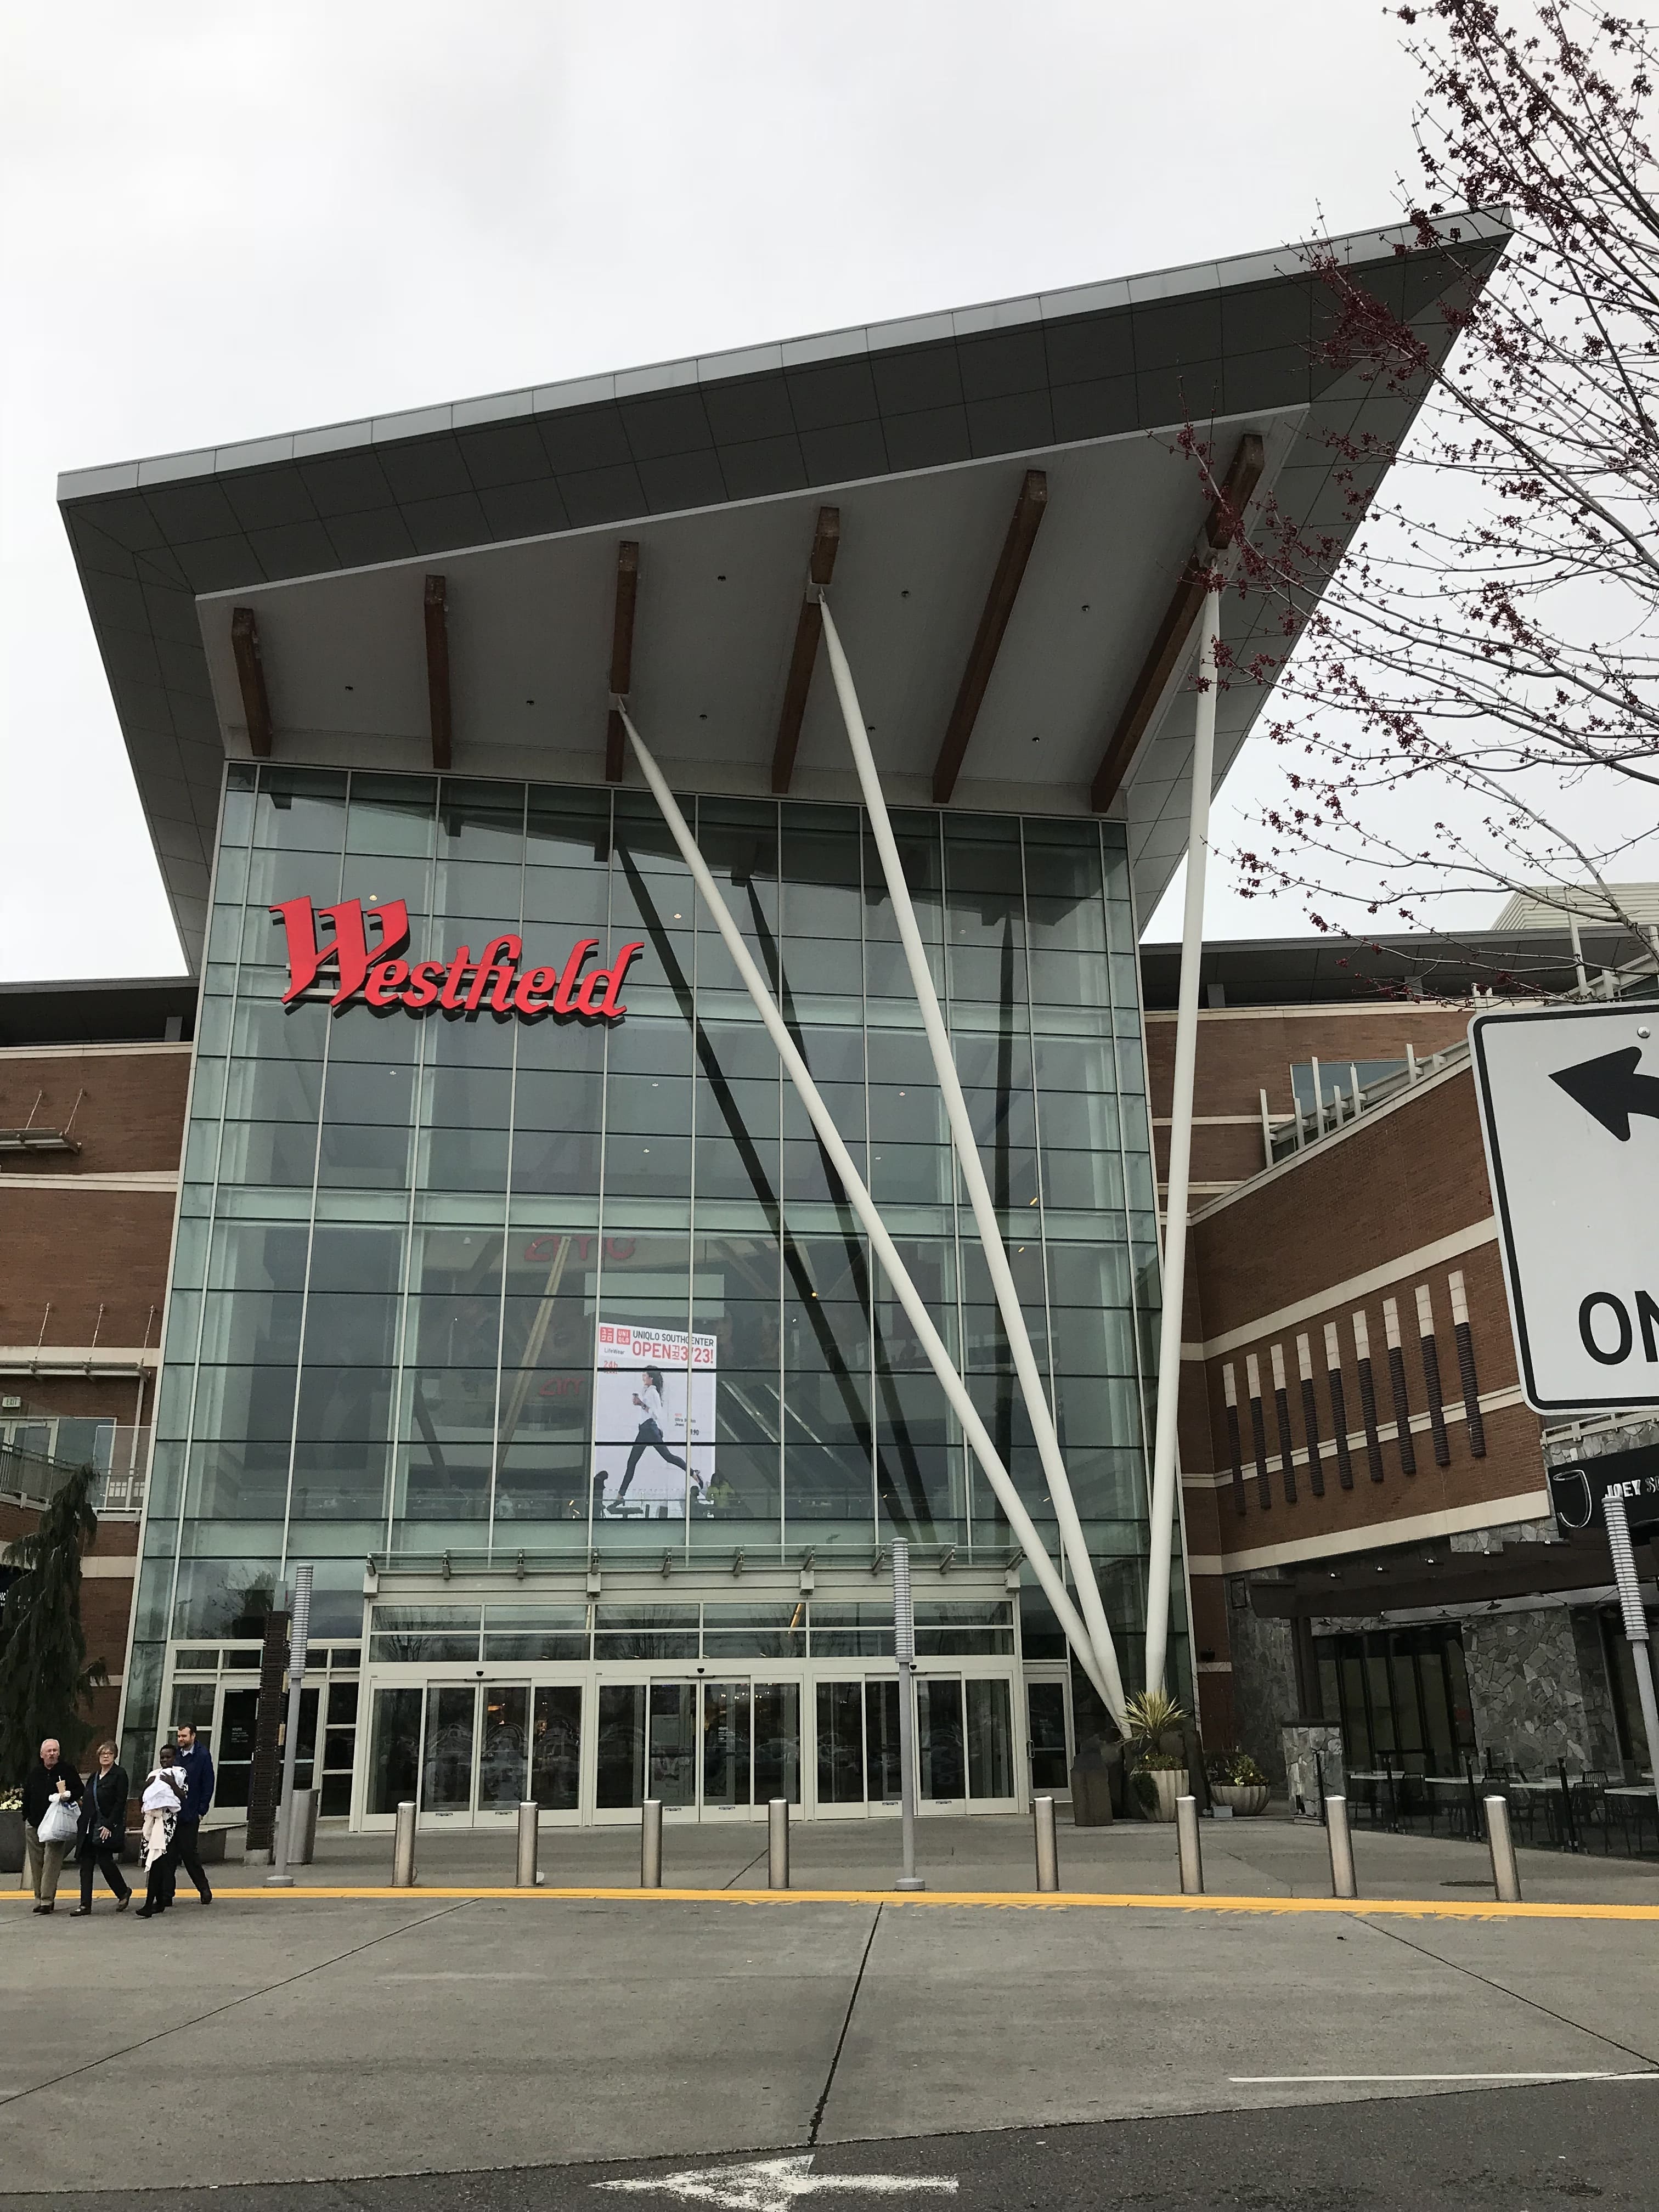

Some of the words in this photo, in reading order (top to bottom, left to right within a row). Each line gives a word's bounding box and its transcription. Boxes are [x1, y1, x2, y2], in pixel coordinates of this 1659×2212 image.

[268, 895, 645, 1018] Westfield
[633, 1330, 659, 1341] UNIQLO
[633, 1341, 671, 1359] OPEN
[1605, 1480, 1641, 1497] JOEY
